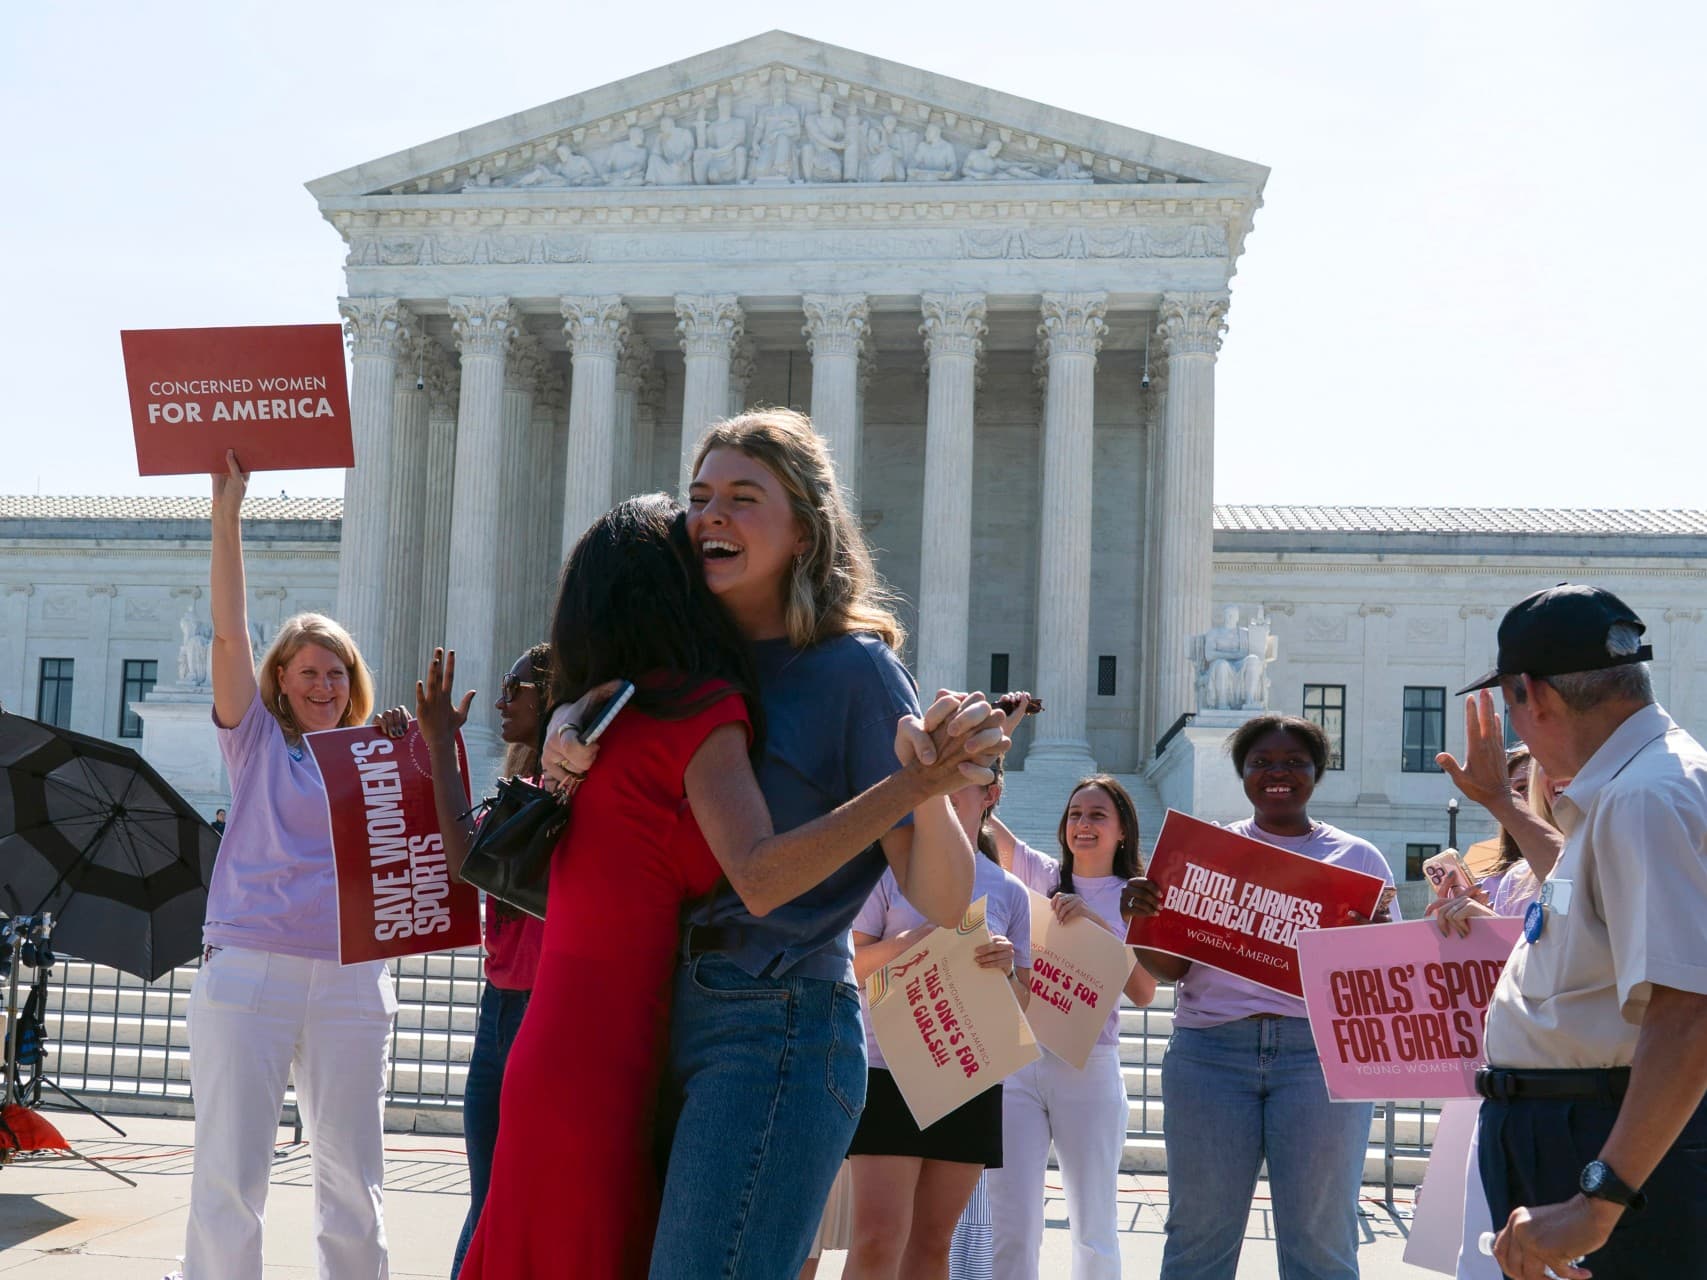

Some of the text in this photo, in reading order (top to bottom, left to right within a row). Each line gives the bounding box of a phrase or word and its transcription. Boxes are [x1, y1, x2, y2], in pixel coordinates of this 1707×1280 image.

[148, 397, 335, 424] FOR AMERICA
[150, 376, 327, 396] CONCERNED WOMEN
[351, 740, 413, 941] SAVE WOMEN'S
[408, 833, 451, 936] SPORTS
[1164, 885, 1310, 949] BIOLOGICAL REAL
[1186, 928, 1289, 971] WOMEN AMERICA
[1030, 976, 1072, 1015] IRLS!!!
[1033, 958, 1098, 1009] ONE'S FOR
[1330, 959, 1507, 1017] GIRLS' SPOR
[906, 976, 951, 1068] THE GIRLS!!!
[924, 964, 980, 1078] THIS ONE'S FOR
[1332, 1017, 1391, 1064] FOR
[1391, 1010, 1478, 1062] GIRLS
[1355, 1065, 1400, 1075] YOUNG
[1406, 1062, 1458, 1074] WOMEN
